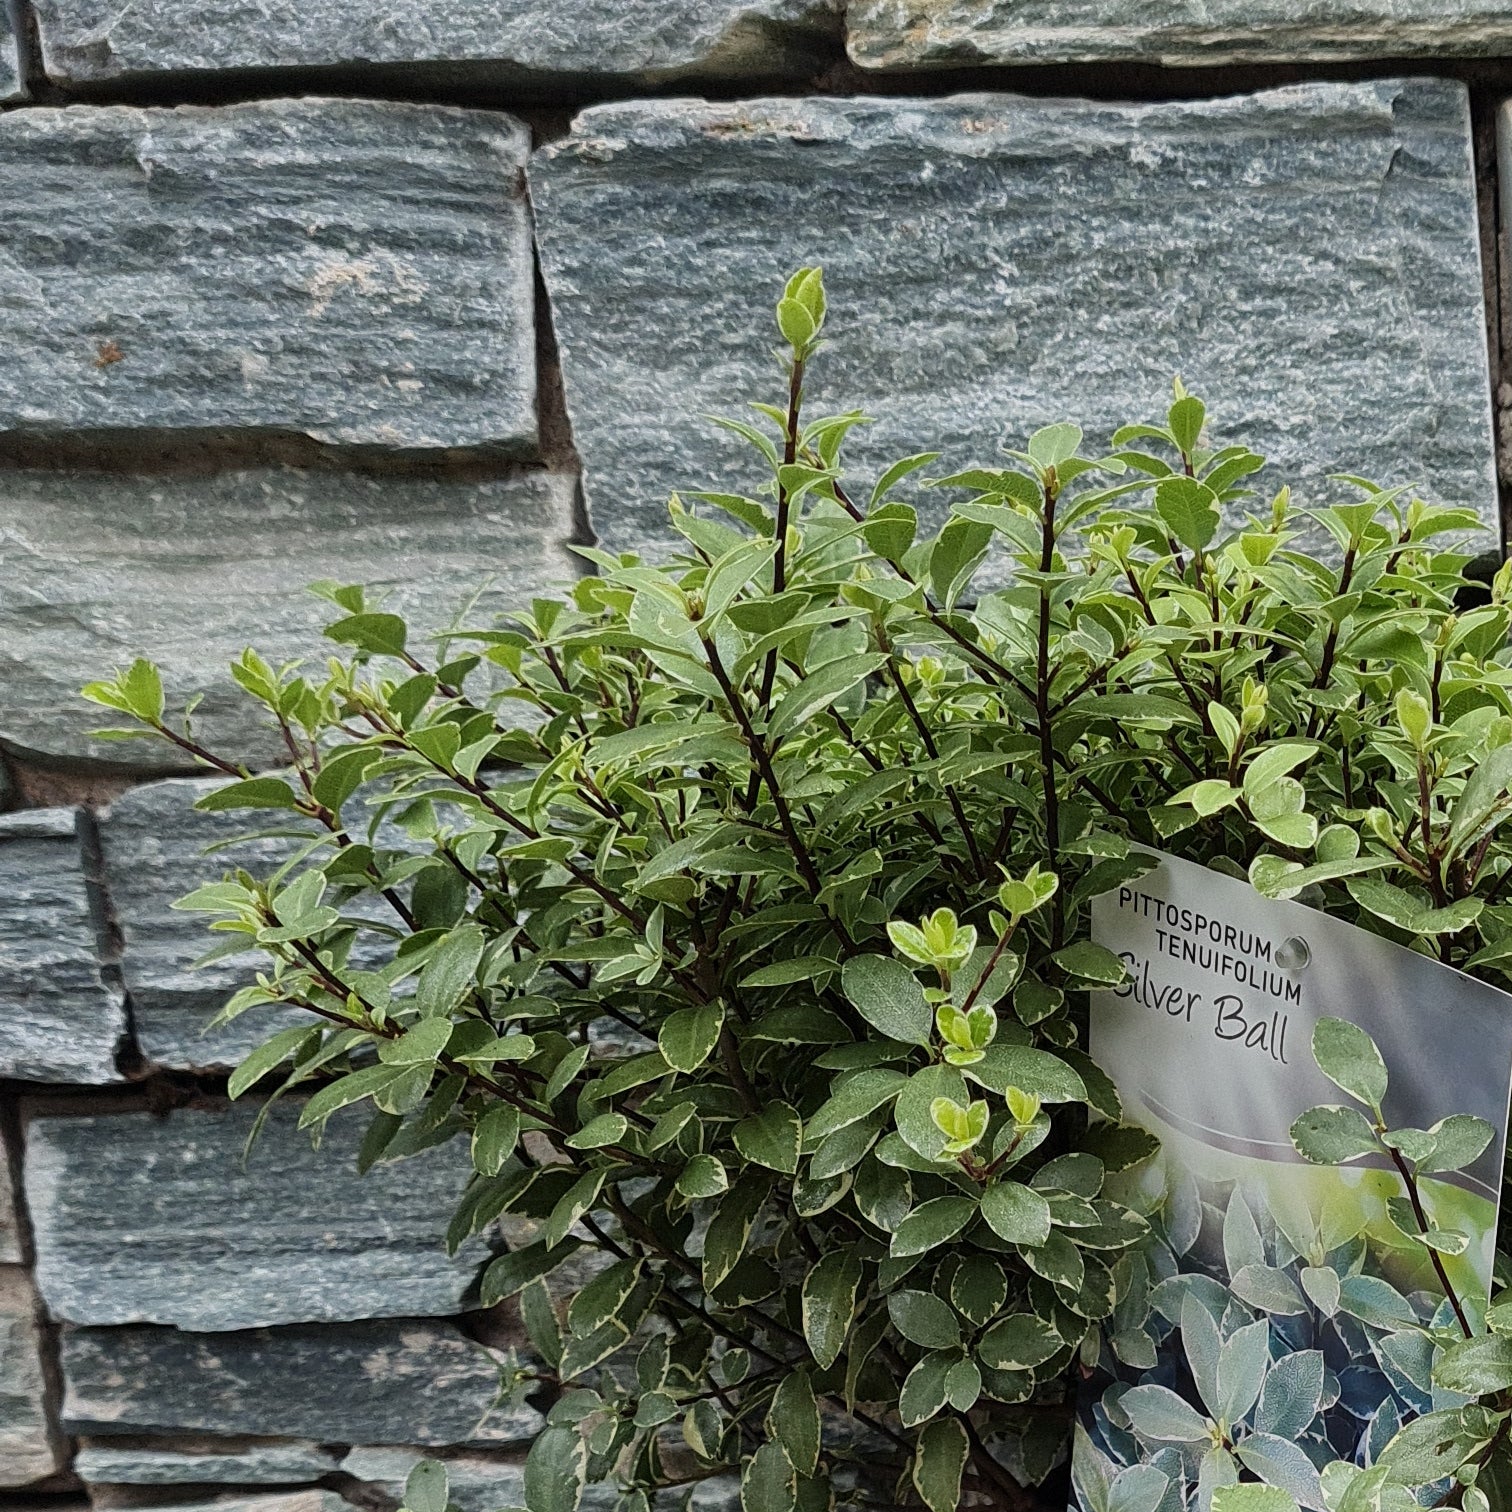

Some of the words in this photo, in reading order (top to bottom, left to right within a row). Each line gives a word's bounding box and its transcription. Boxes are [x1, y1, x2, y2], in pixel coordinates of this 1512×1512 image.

[1119, 886, 1272, 963] PITTOSPORUM
[1155, 928, 1302, 1006] TENUIFOLIUM
[1213, 994, 1288, 1064] Ball
